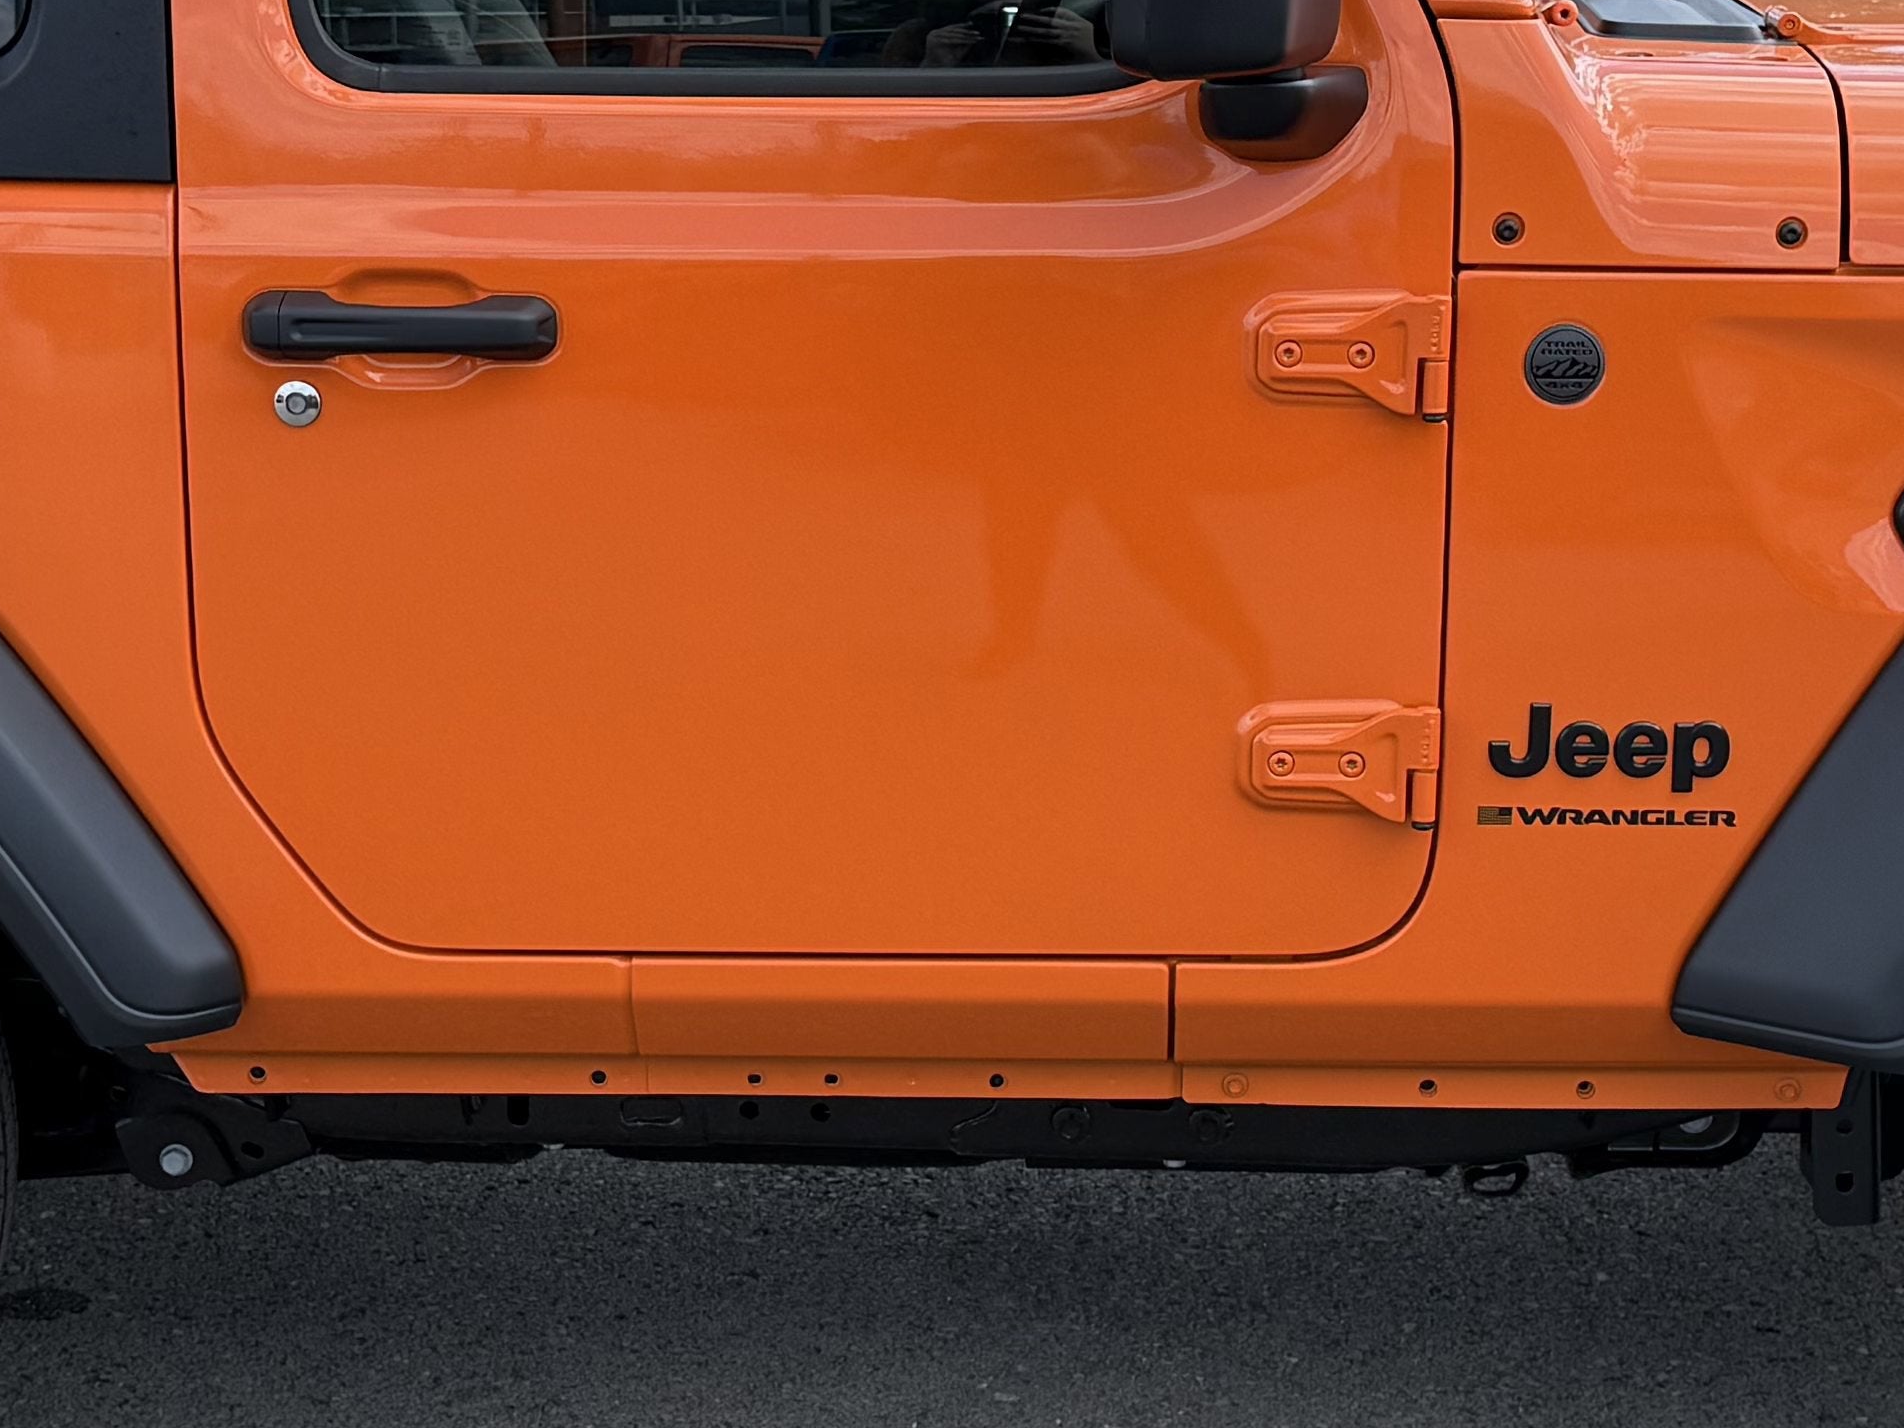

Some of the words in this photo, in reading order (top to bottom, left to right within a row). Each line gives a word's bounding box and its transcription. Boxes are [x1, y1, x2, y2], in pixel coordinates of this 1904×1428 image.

[1544, 340, 1589, 348] TRAIL
[1540, 348, 1594, 356] RATED
[1487, 701, 1731, 794] Jeep
[1516, 806, 1737, 828] WRANGLER
